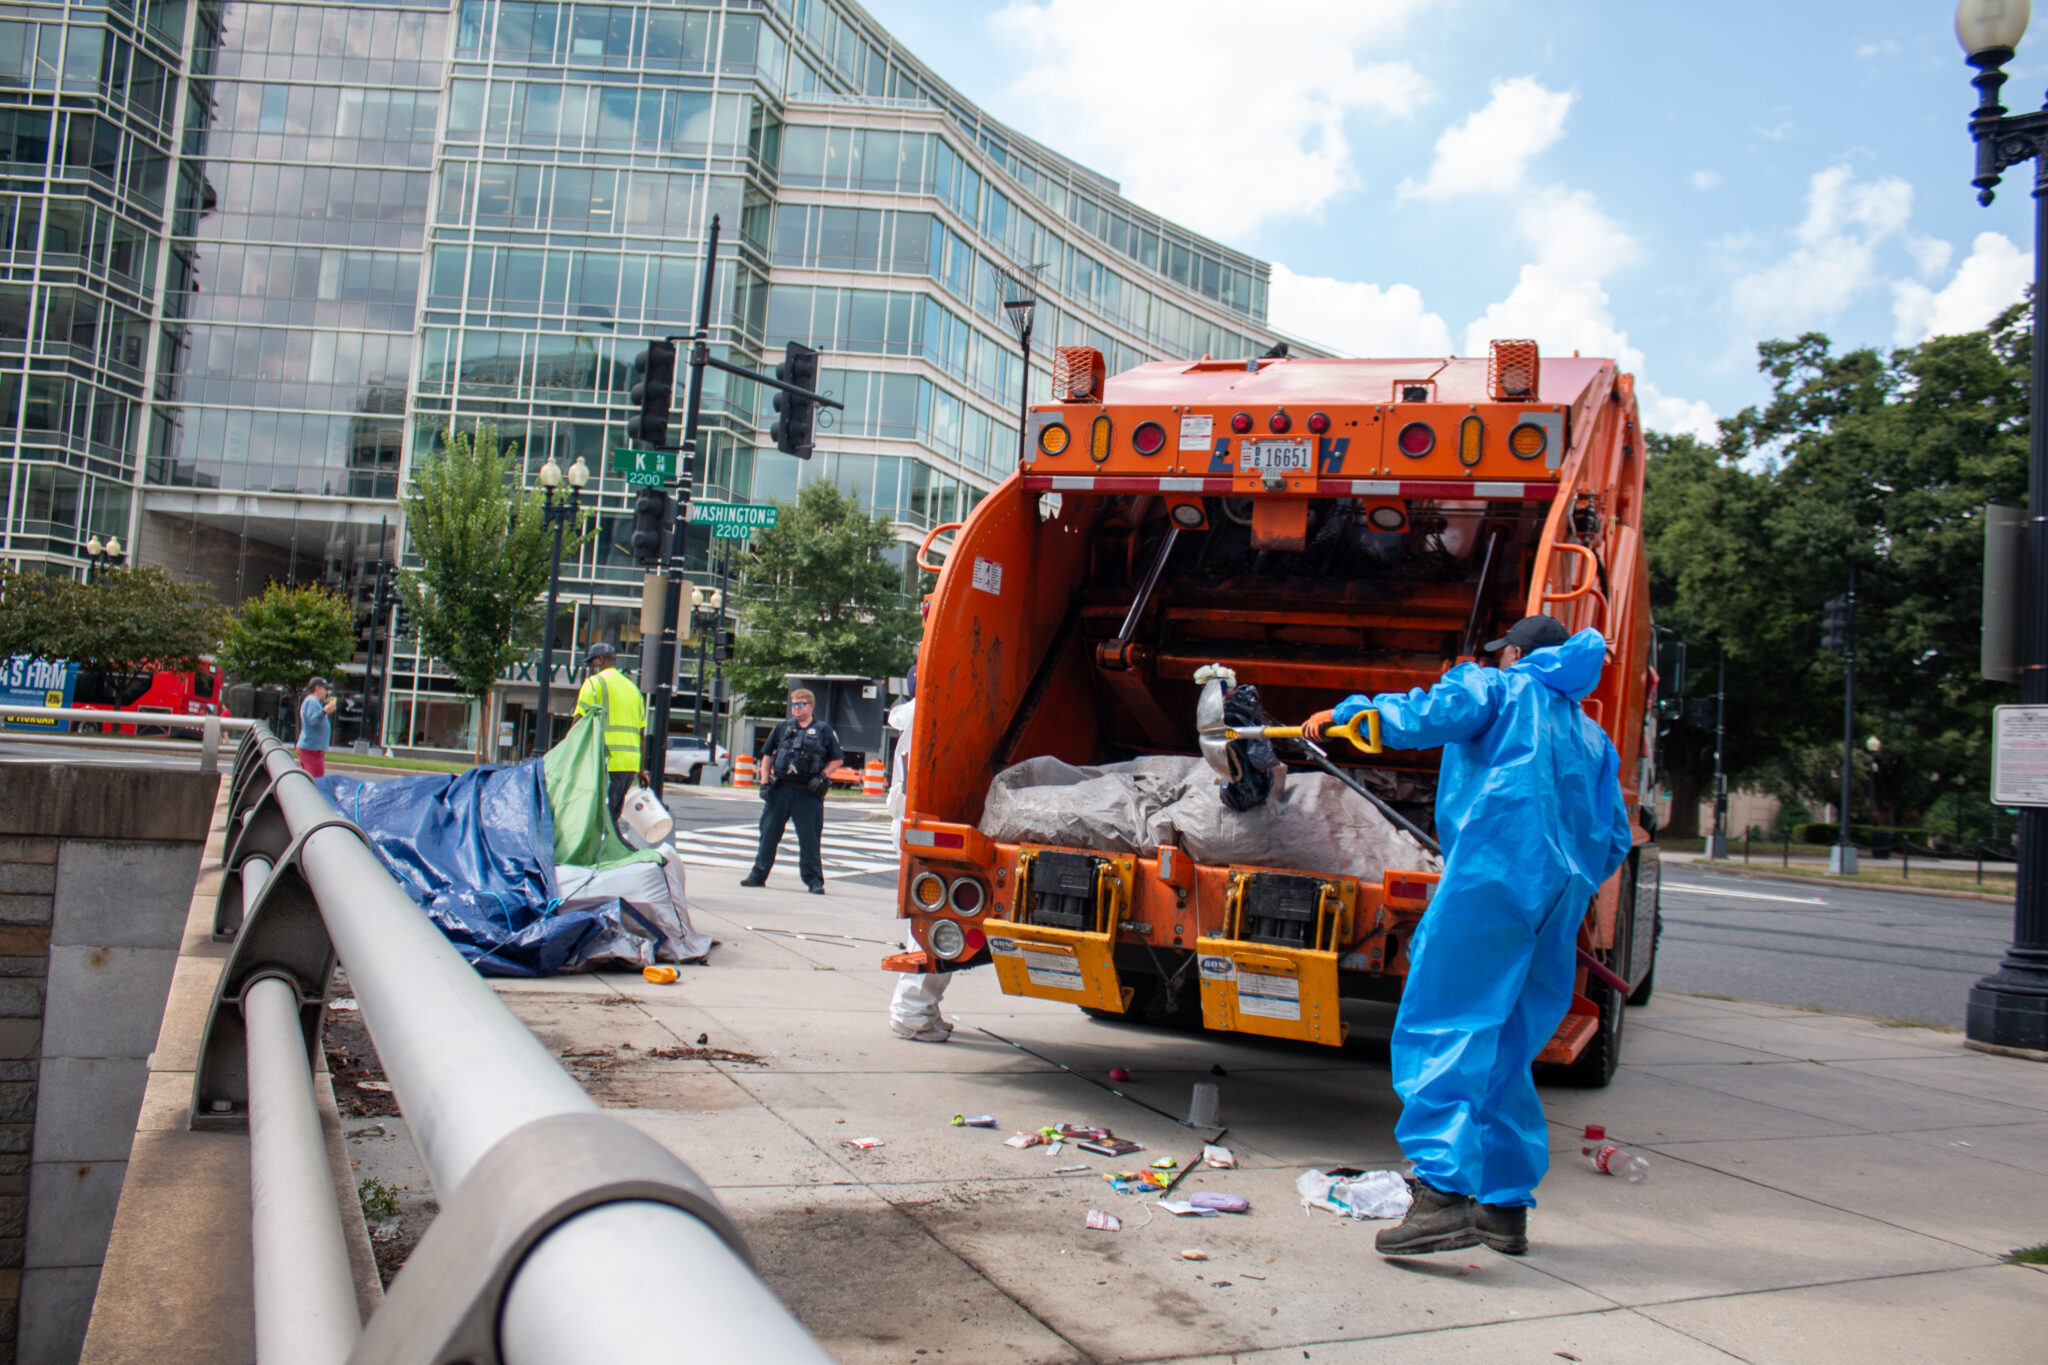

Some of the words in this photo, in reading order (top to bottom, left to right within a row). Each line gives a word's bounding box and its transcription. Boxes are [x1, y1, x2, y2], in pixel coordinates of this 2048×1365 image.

[635, 453, 647, 472] K
[1266, 447, 1308, 467] 16651
[629, 472, 660, 486] 2200
[693, 505, 766, 524] WASHINGTON
[716, 524, 748, 538] 2200
[25, 660, 67, 690] FIRM
